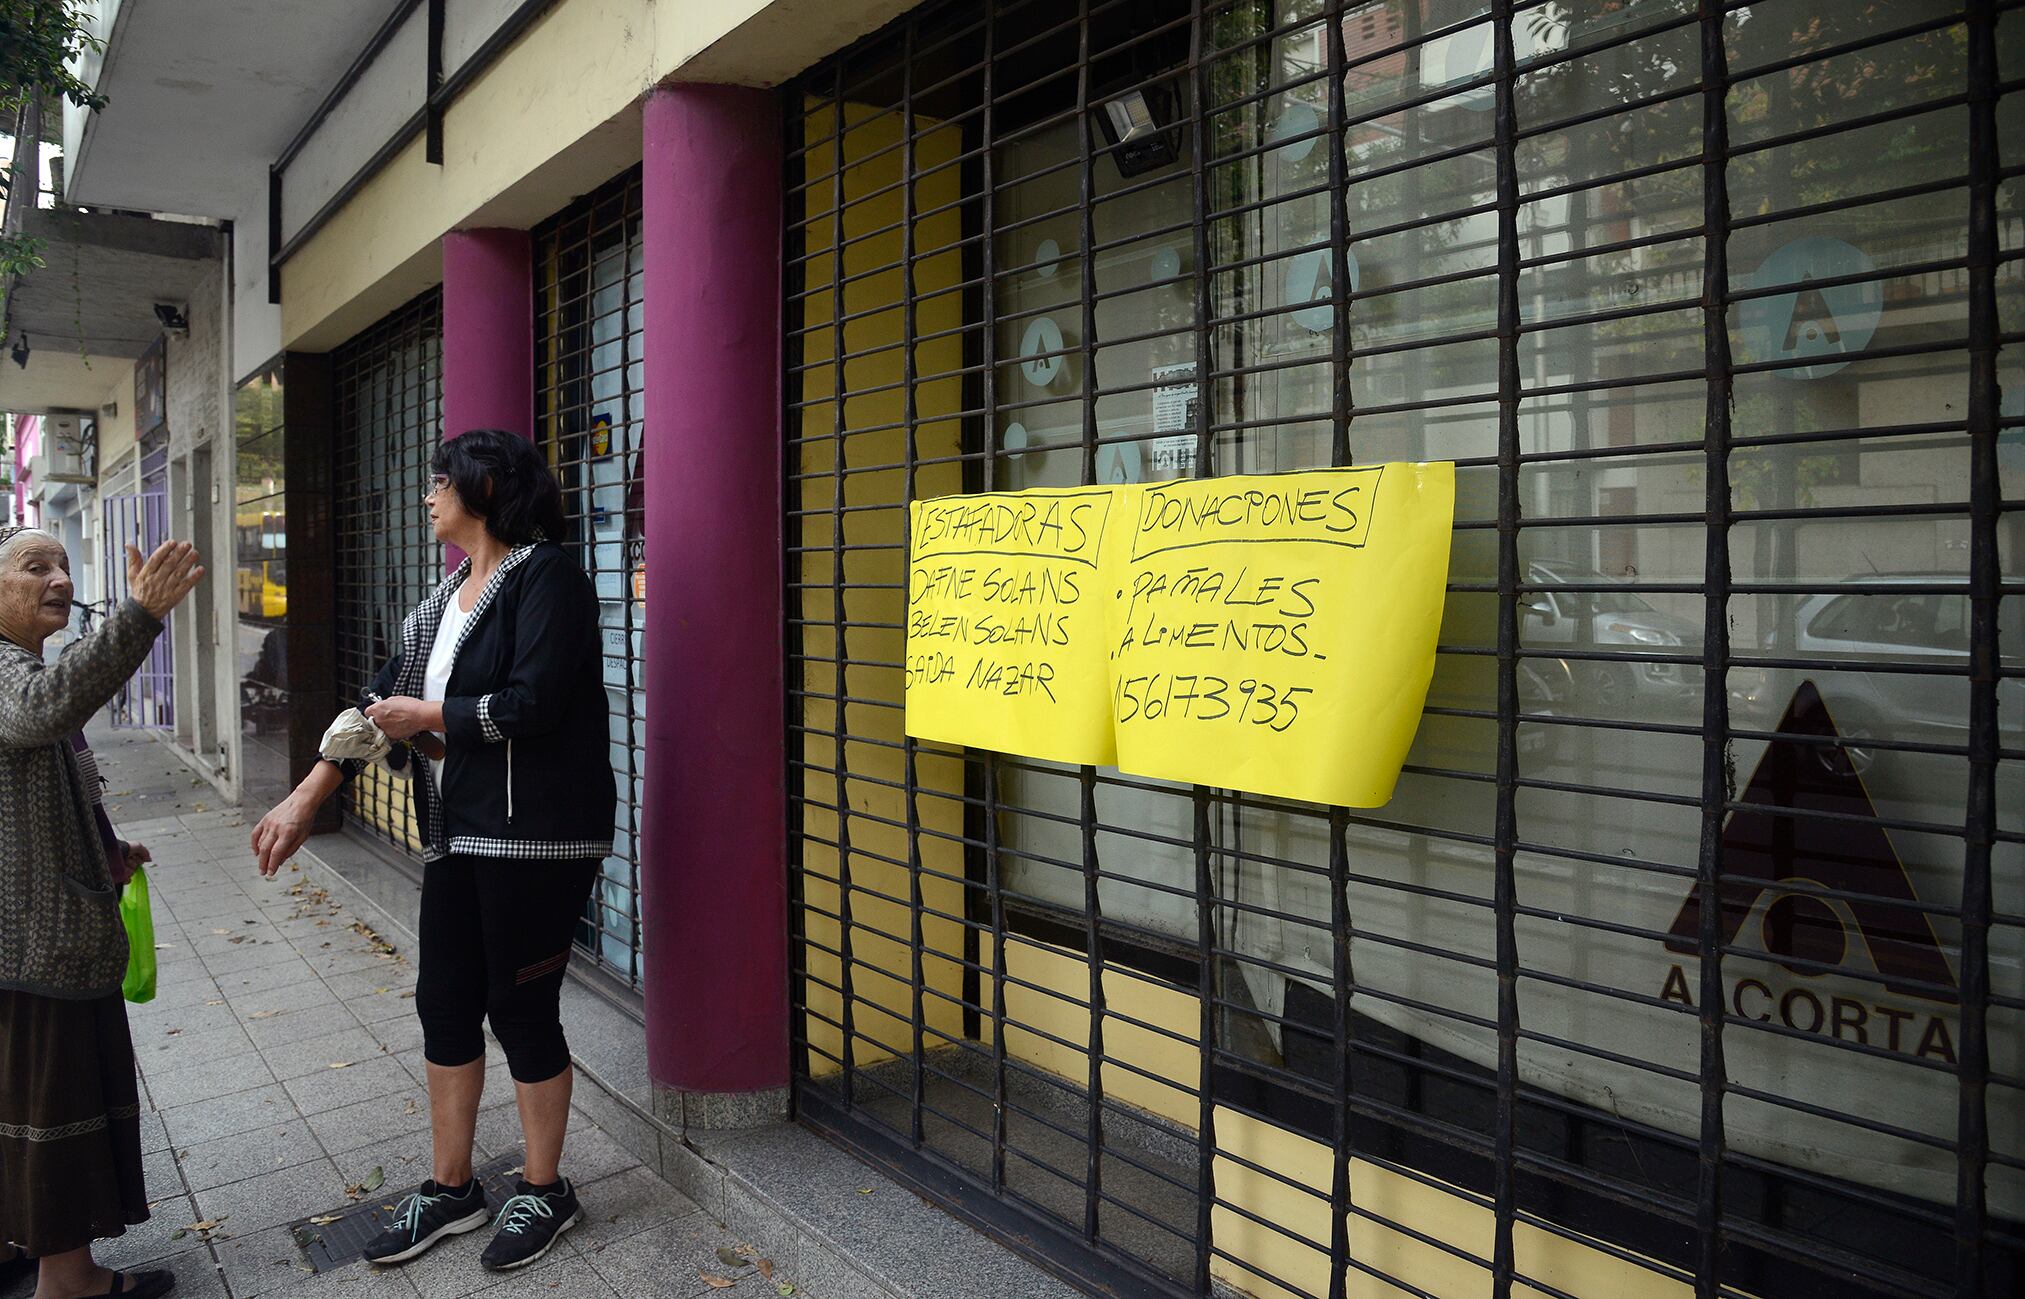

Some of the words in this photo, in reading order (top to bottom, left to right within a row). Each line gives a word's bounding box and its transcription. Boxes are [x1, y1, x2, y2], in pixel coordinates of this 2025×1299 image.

[911, 566, 976, 605] DAFNE
[983, 567, 1080, 605] SOLANS
[909, 610, 969, 643] BELEN
[973, 612, 1070, 646] SOLANS
[966, 656, 1057, 704] NAZAR
[1659, 963, 1958, 1063] ACORTA
